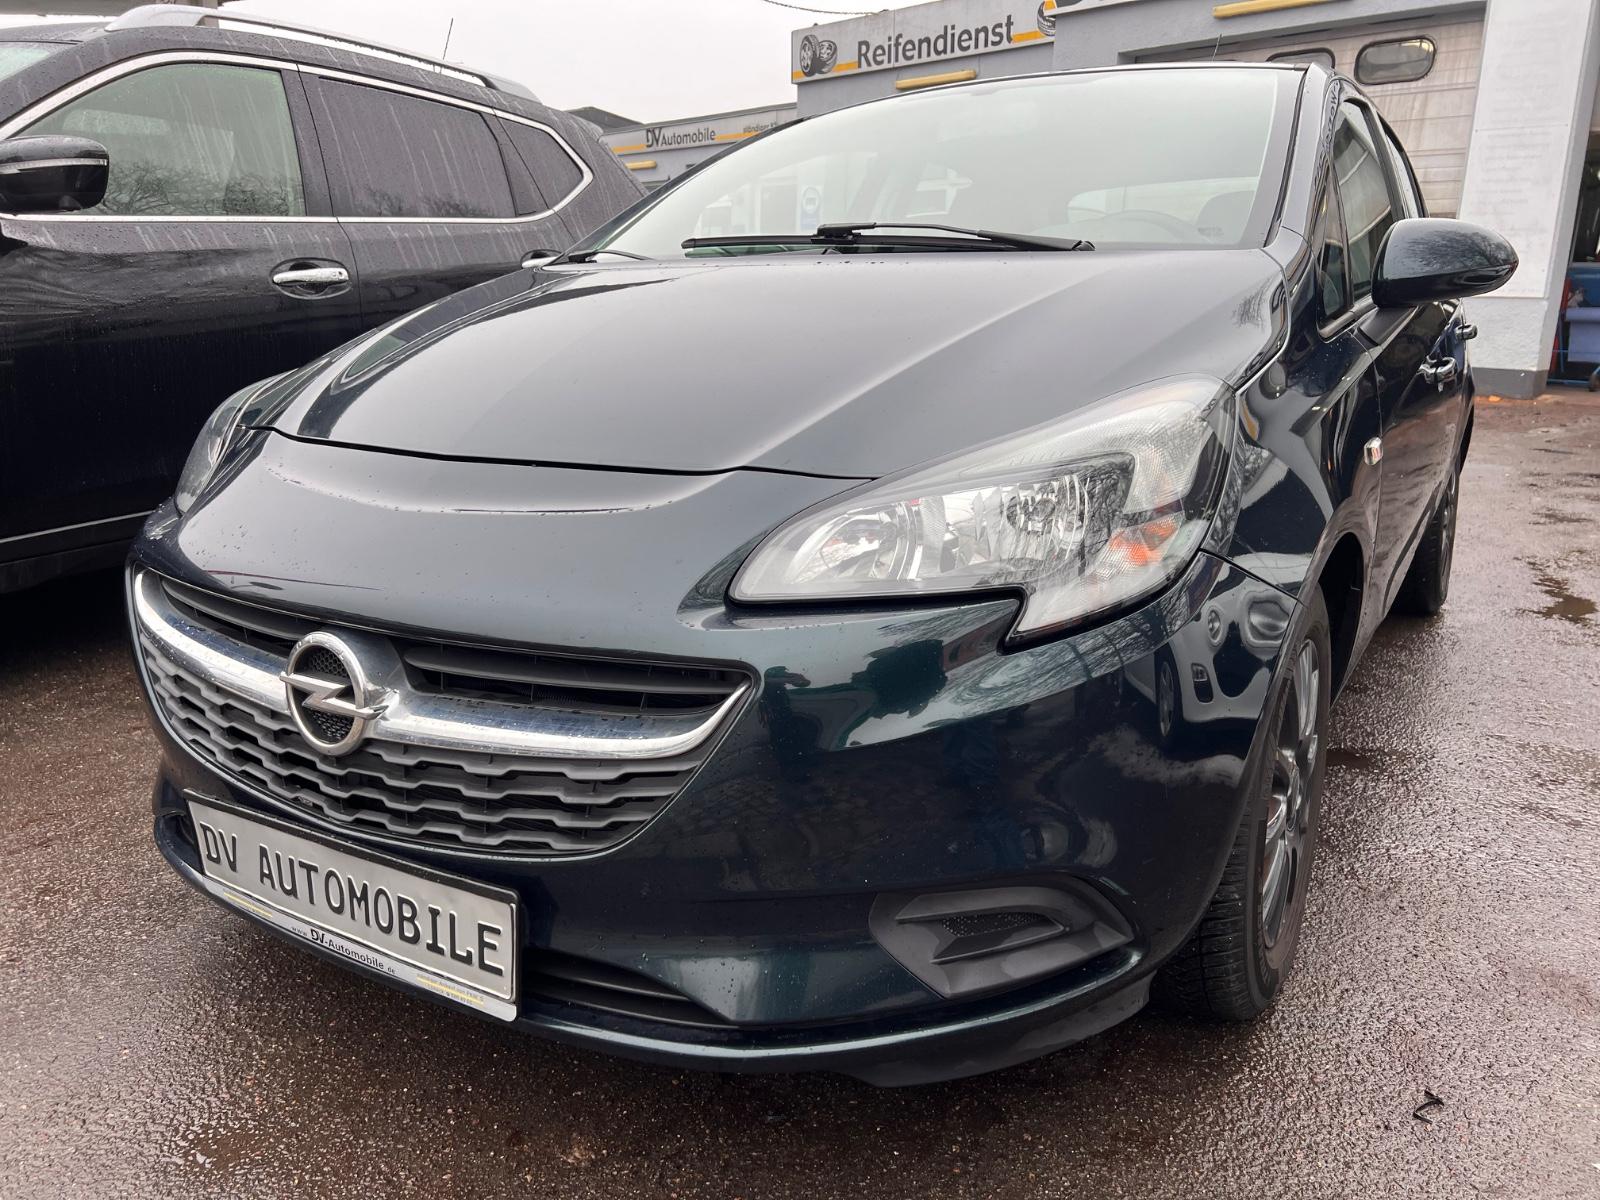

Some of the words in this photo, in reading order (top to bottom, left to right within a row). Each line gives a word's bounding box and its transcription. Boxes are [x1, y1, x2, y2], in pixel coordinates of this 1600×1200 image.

[857, 14, 1014, 68] Reifendienst
[200, 821, 238, 873] DV
[259, 844, 504, 977] AUTOMOBILE
